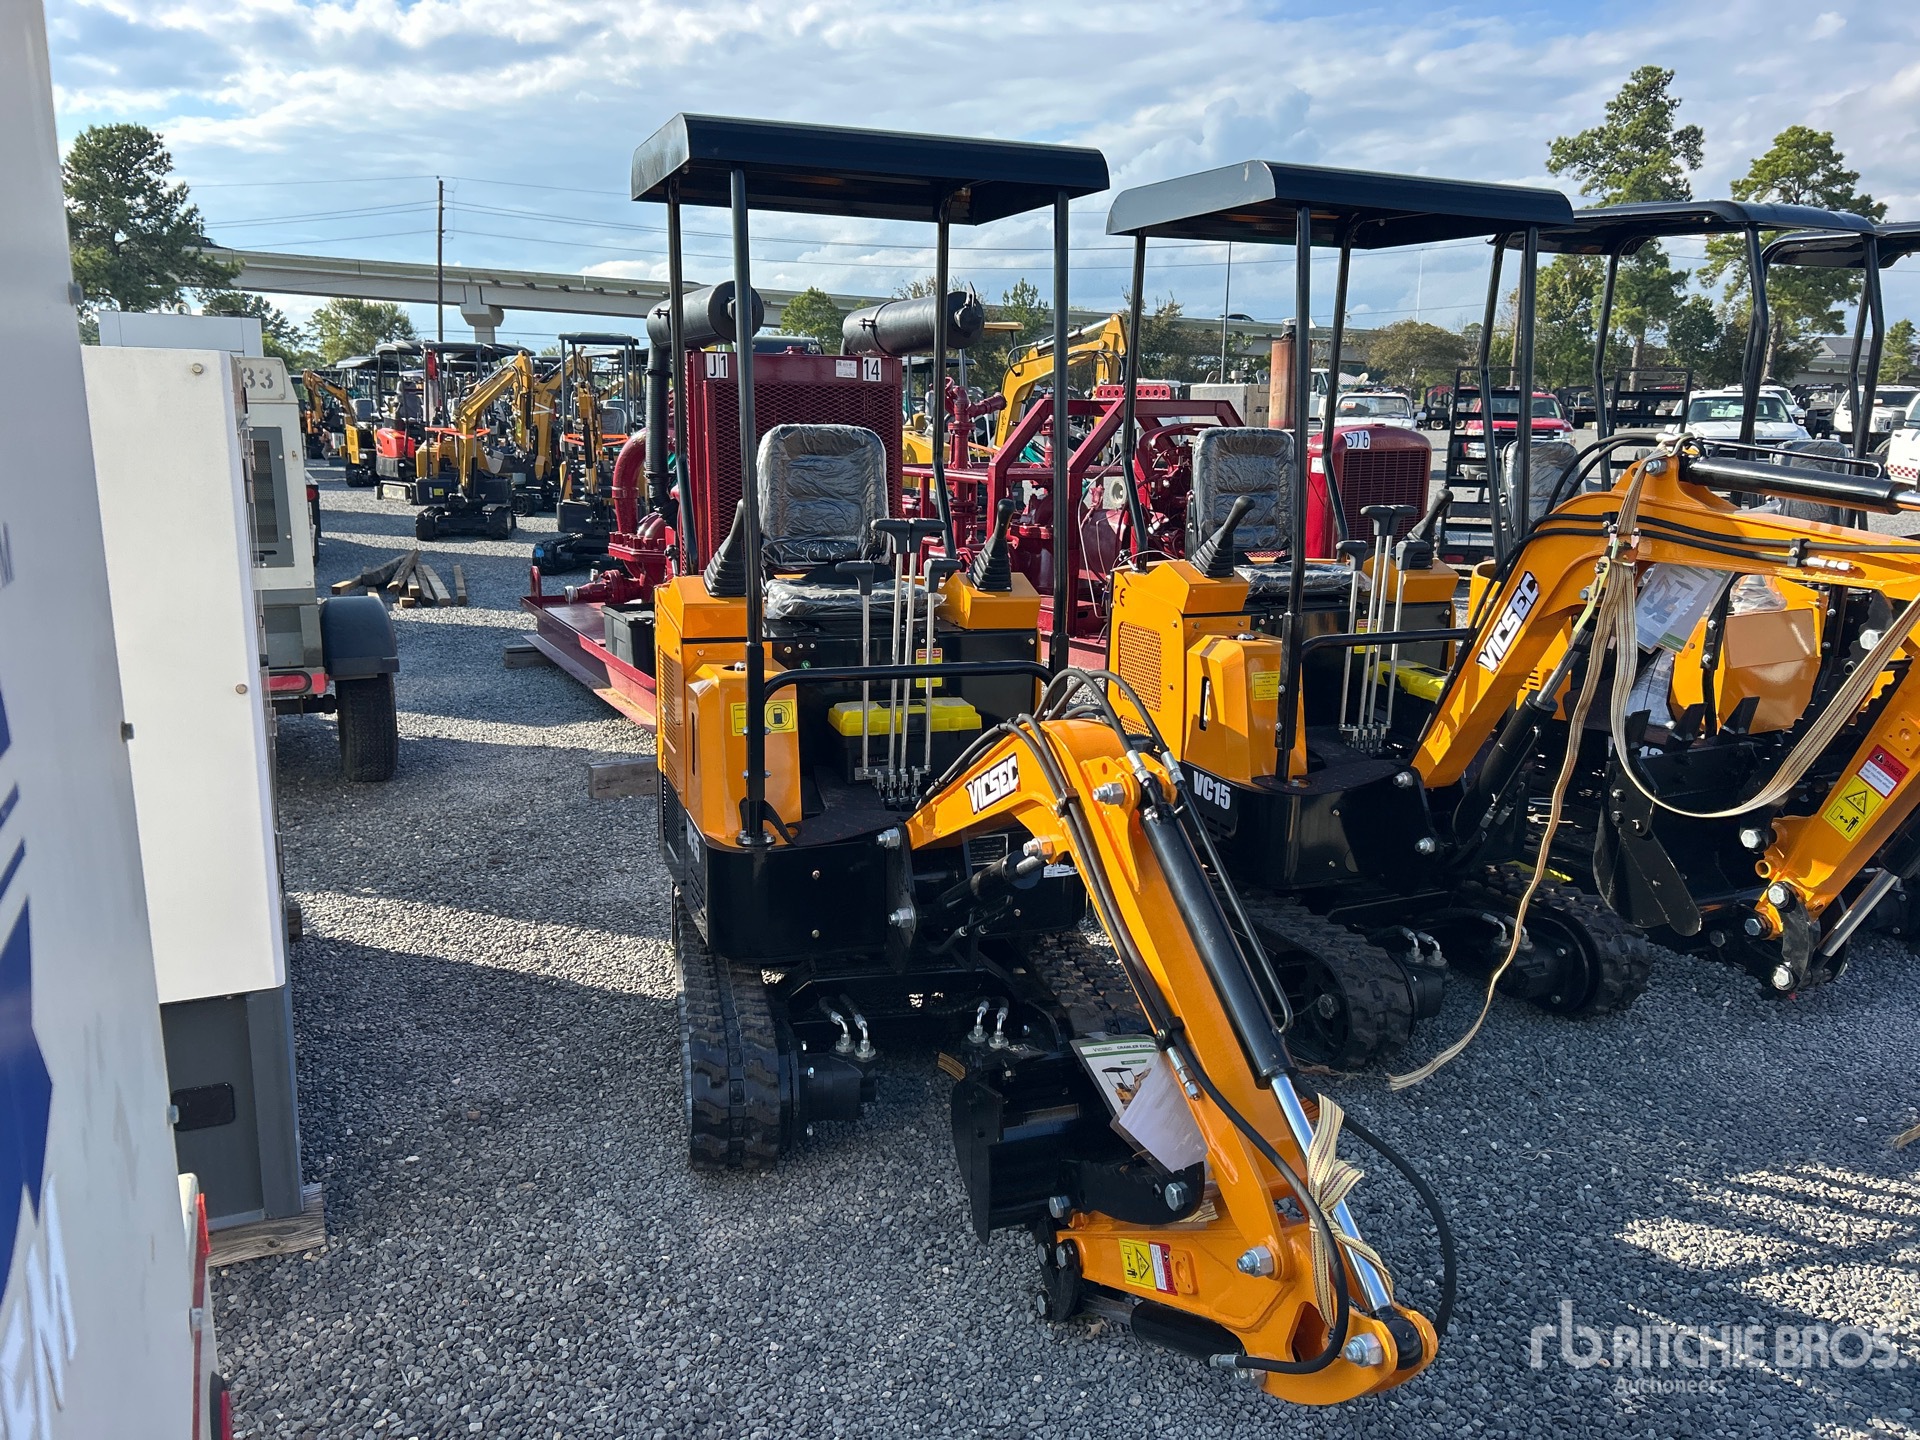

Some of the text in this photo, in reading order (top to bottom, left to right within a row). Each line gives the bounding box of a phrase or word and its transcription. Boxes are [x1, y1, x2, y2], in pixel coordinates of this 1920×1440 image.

[709, 353, 727, 377] J1
[864, 358, 880, 381] 14
[1476, 571, 1540, 672] VICSEC
[966, 753, 1019, 814] VICSEC
[1193, 770, 1231, 810] VC15
